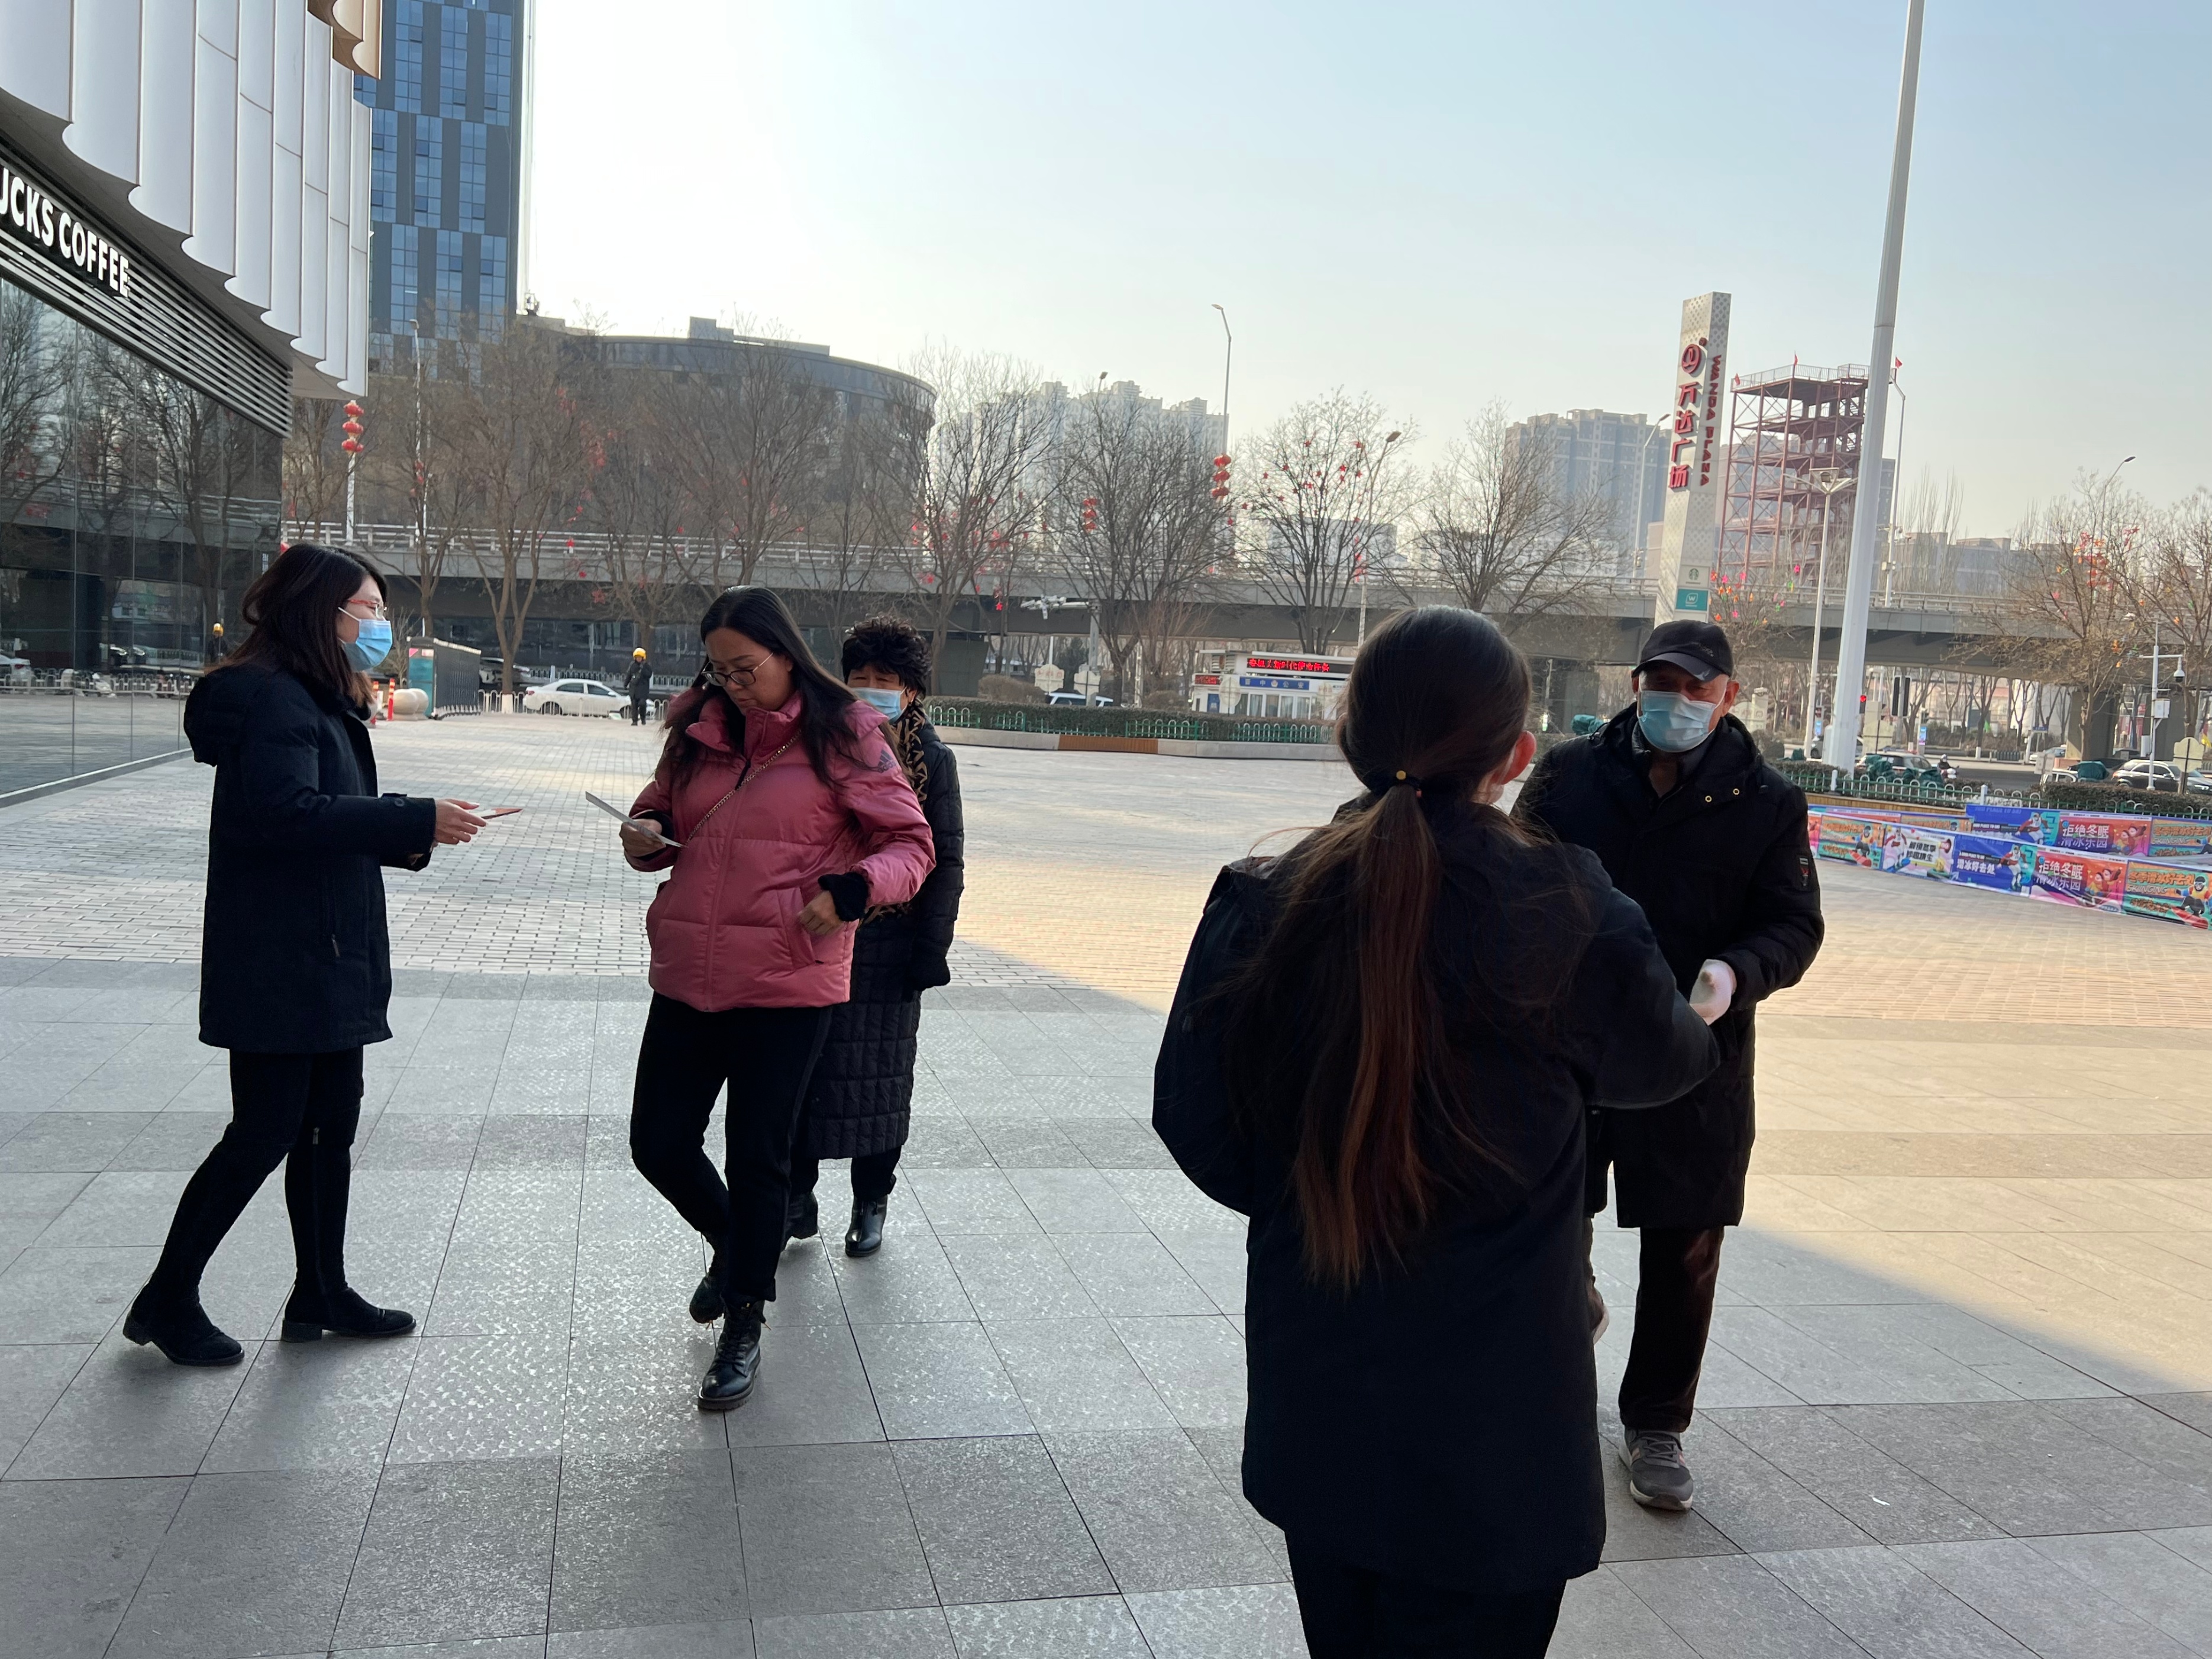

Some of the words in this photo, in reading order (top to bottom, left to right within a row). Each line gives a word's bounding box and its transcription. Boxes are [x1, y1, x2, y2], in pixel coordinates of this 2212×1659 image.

[59, 212, 129, 298] COFFEE
[1706, 354, 1722, 419] WANDA
[1668, 382, 1699, 489] 万达广场
[1700, 427, 1714, 486] PLAZA
[2062, 824, 2110, 839] 拒绝冬眠
[2038, 860, 2084, 880] 拒绝冬眠
